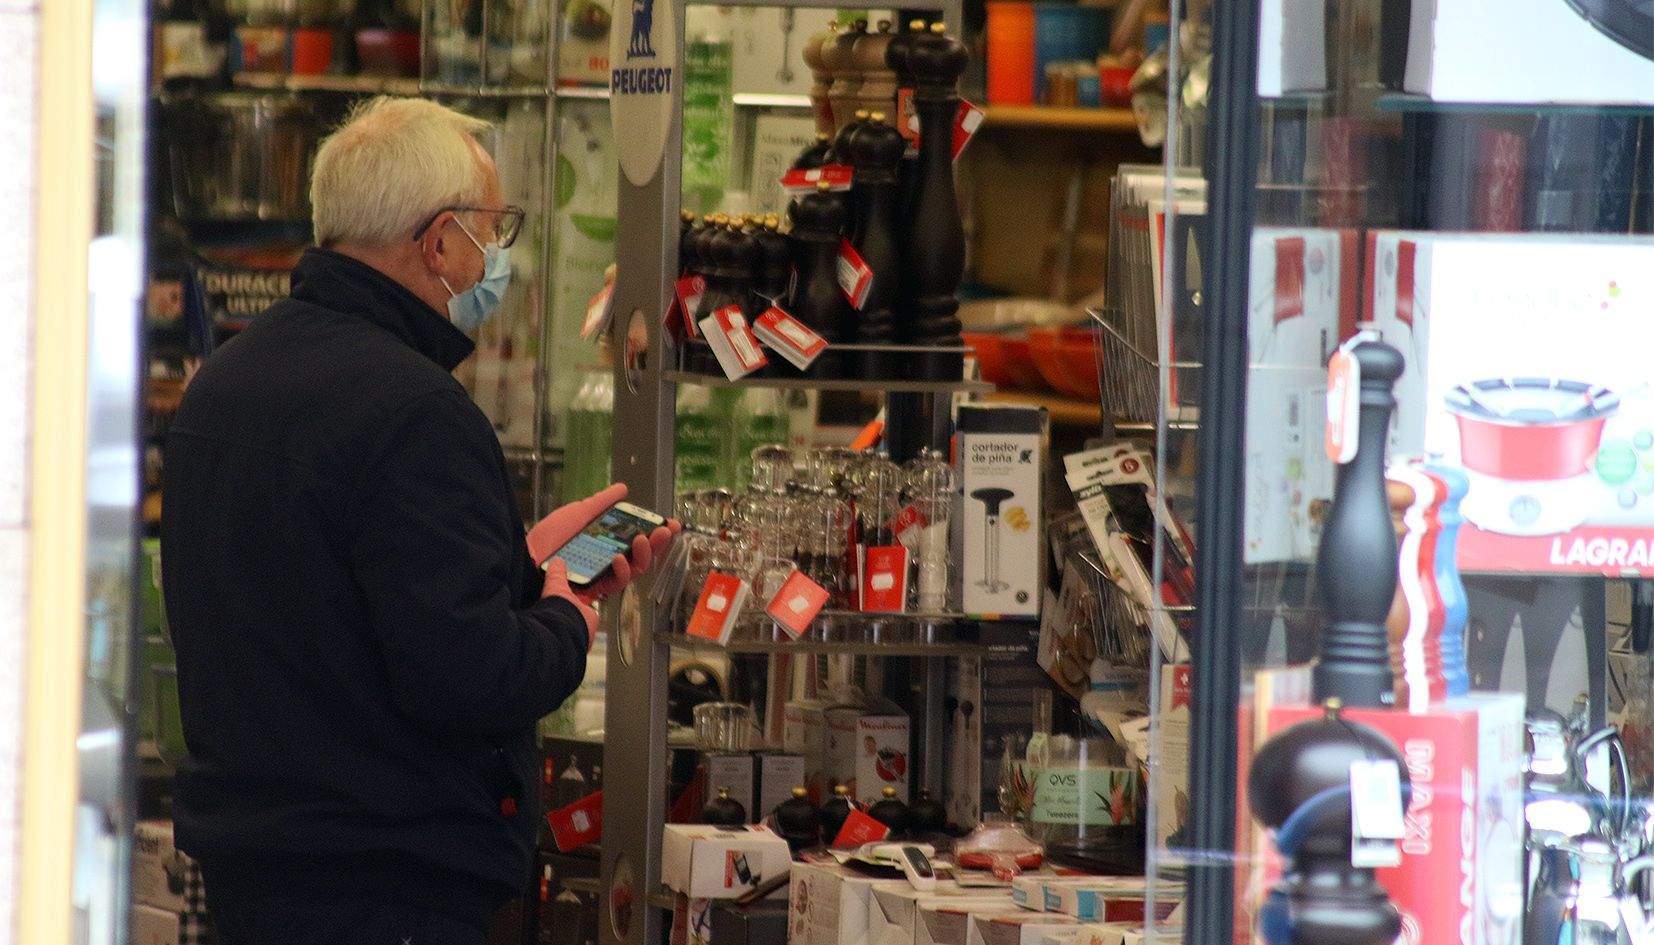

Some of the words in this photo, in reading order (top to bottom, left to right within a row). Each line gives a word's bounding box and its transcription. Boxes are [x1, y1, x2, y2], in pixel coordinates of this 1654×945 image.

[612, 68, 672, 94] PEUGEOT
[972, 442, 1018, 452] cortador
[972, 454, 985, 462] de
[988, 454, 1012, 465] piña
[1549, 537, 1654, 567] LAGRA
[1049, 774, 1077, 787] QVS
